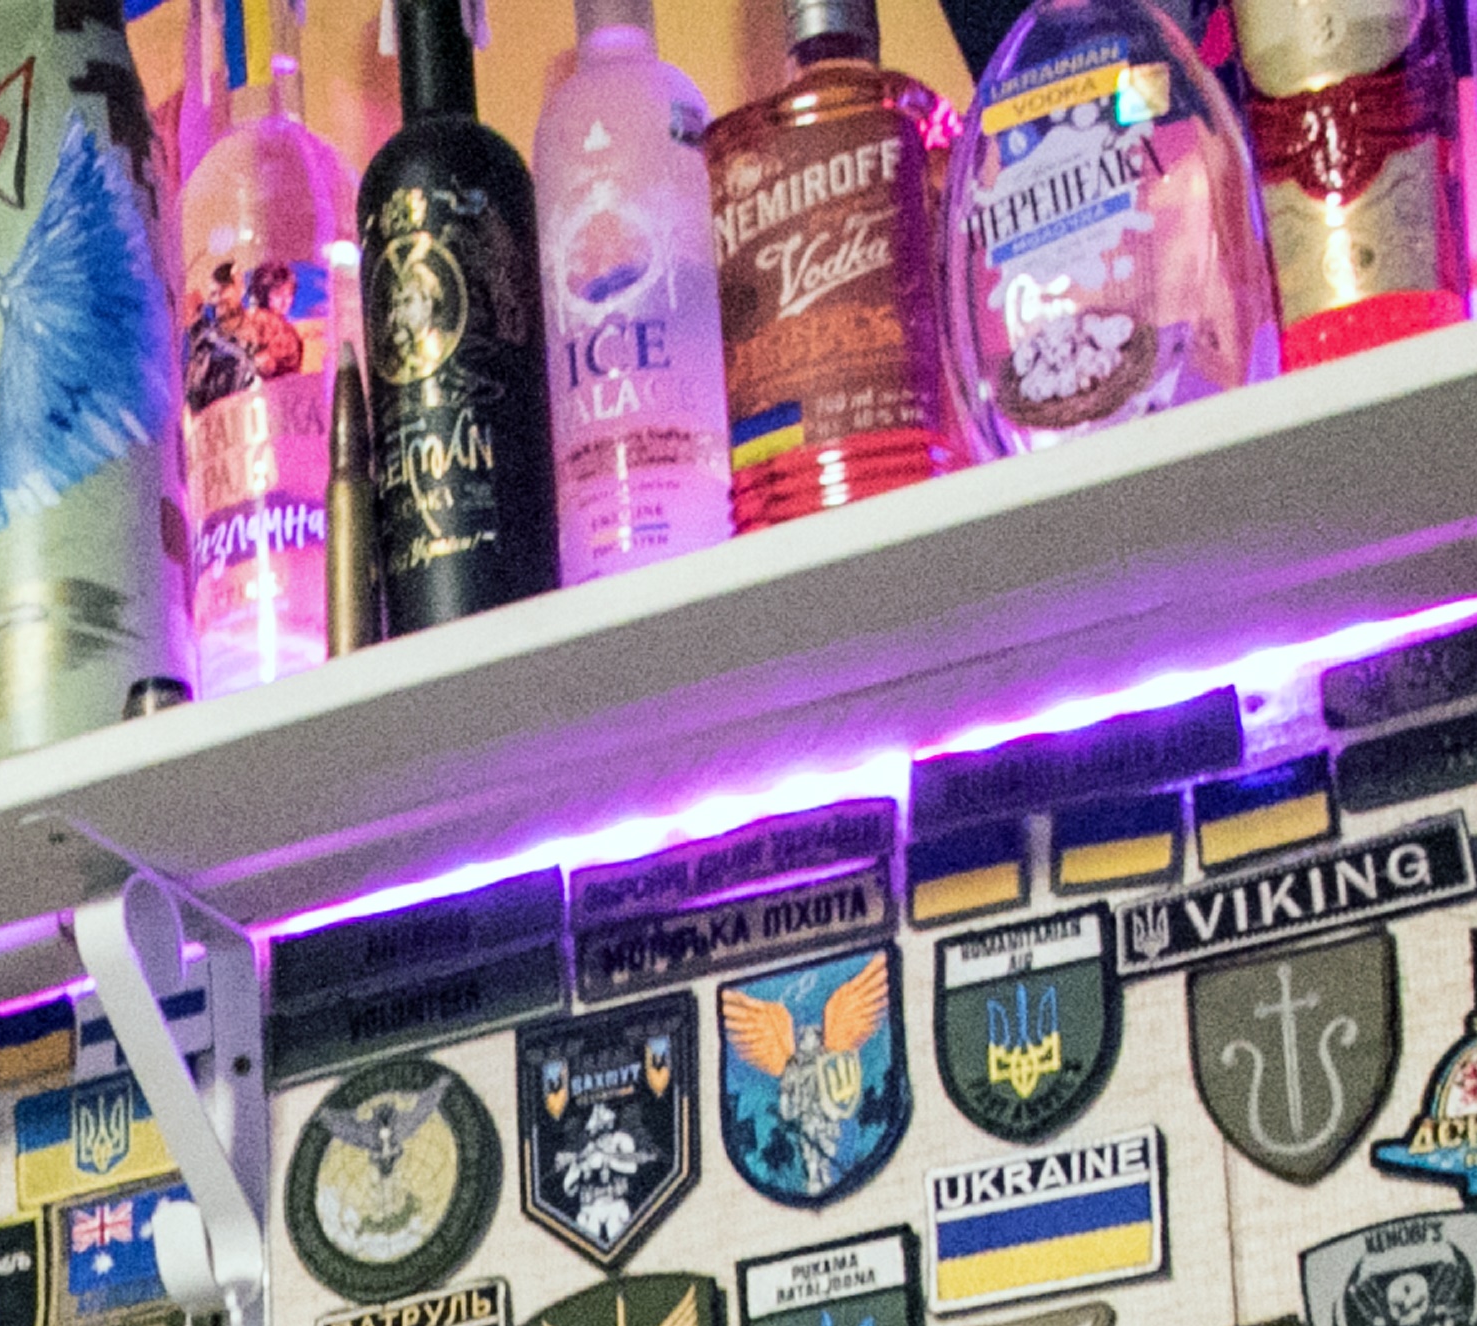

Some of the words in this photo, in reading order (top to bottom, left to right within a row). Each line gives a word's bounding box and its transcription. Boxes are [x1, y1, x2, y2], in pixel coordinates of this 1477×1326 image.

[989, 42, 1124, 100] UKRAINIAN
[1012, 74, 1099, 119] VODKA
[713, 137, 904, 262] NEMIROFF
[756, 212, 892, 320] Vodka
[566, 320, 672, 388] ICE
[1185, 843, 1432, 942] VIKING
[936, 1136, 1150, 1210] UKRAINE
